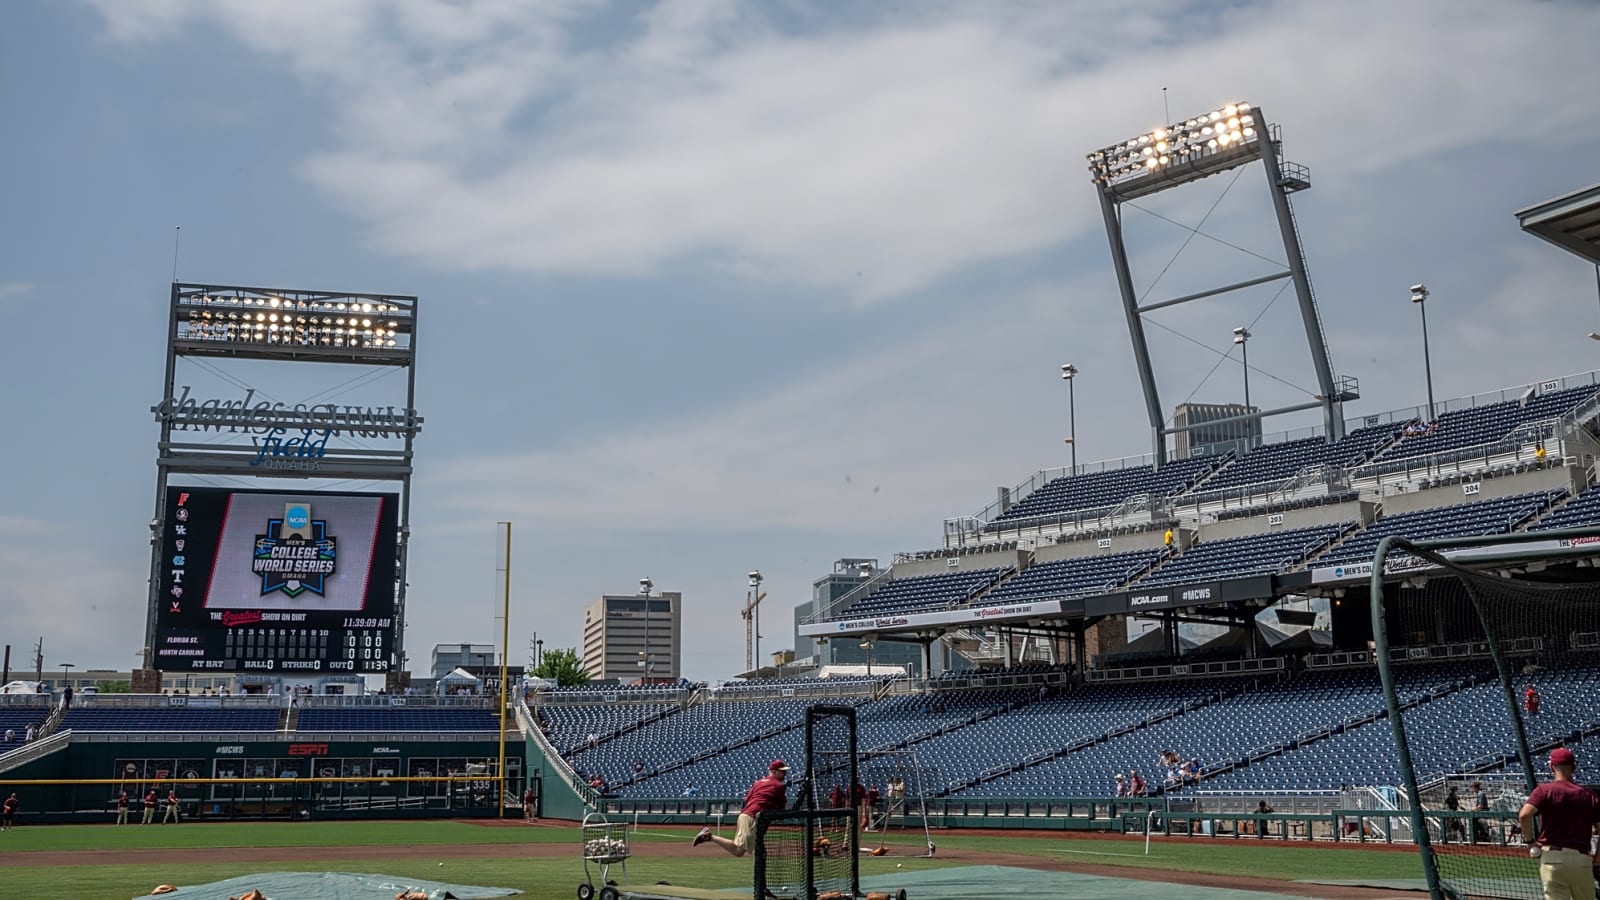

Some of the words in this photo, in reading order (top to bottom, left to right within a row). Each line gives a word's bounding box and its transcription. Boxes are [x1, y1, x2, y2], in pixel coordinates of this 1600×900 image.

[1543, 383, 1557, 391] 303
[156, 386, 285, 421] charles
[293, 404, 419, 429] SCHWAB
[250, 427, 333, 466] field
[264, 460, 320, 471] OMAHA
[1464, 484, 1479, 493] 204
[270, 546, 319, 560] COLLEGE
[253, 559, 294, 573] WORLD
[293, 560, 334, 573] SERIES
[1344, 566, 1361, 576] MEN'S
[1182, 588, 1211, 600] #MCWS
[1131, 595, 1168, 606] NCAA.com
[210, 612, 222, 620] THE
[261, 613, 280, 621] SHOW
[281, 613, 290, 621] ON
[291, 613, 307, 621] DIRT
[343, 618, 376, 627] 11:39:09
[377, 619, 390, 627] AM
[349, 636, 355, 647] 0
[365, 636, 372, 647] 0
[375, 636, 381, 647] 0
[348, 648, 355, 659] 0
[364, 648, 371, 659] 0
[374, 648, 381, 659] 0
[192, 660, 204, 668] AT
[206, 660, 224, 668] BAT
[267, 660, 274, 669] 0
[282, 661, 313, 669] STRIKE
[314, 660, 320, 670] 0
[347, 660, 354, 670] 0
[216, 746, 244, 754] #MCWS
[288, 744, 328, 755] ESPN
[473, 781, 490, 789] 335
